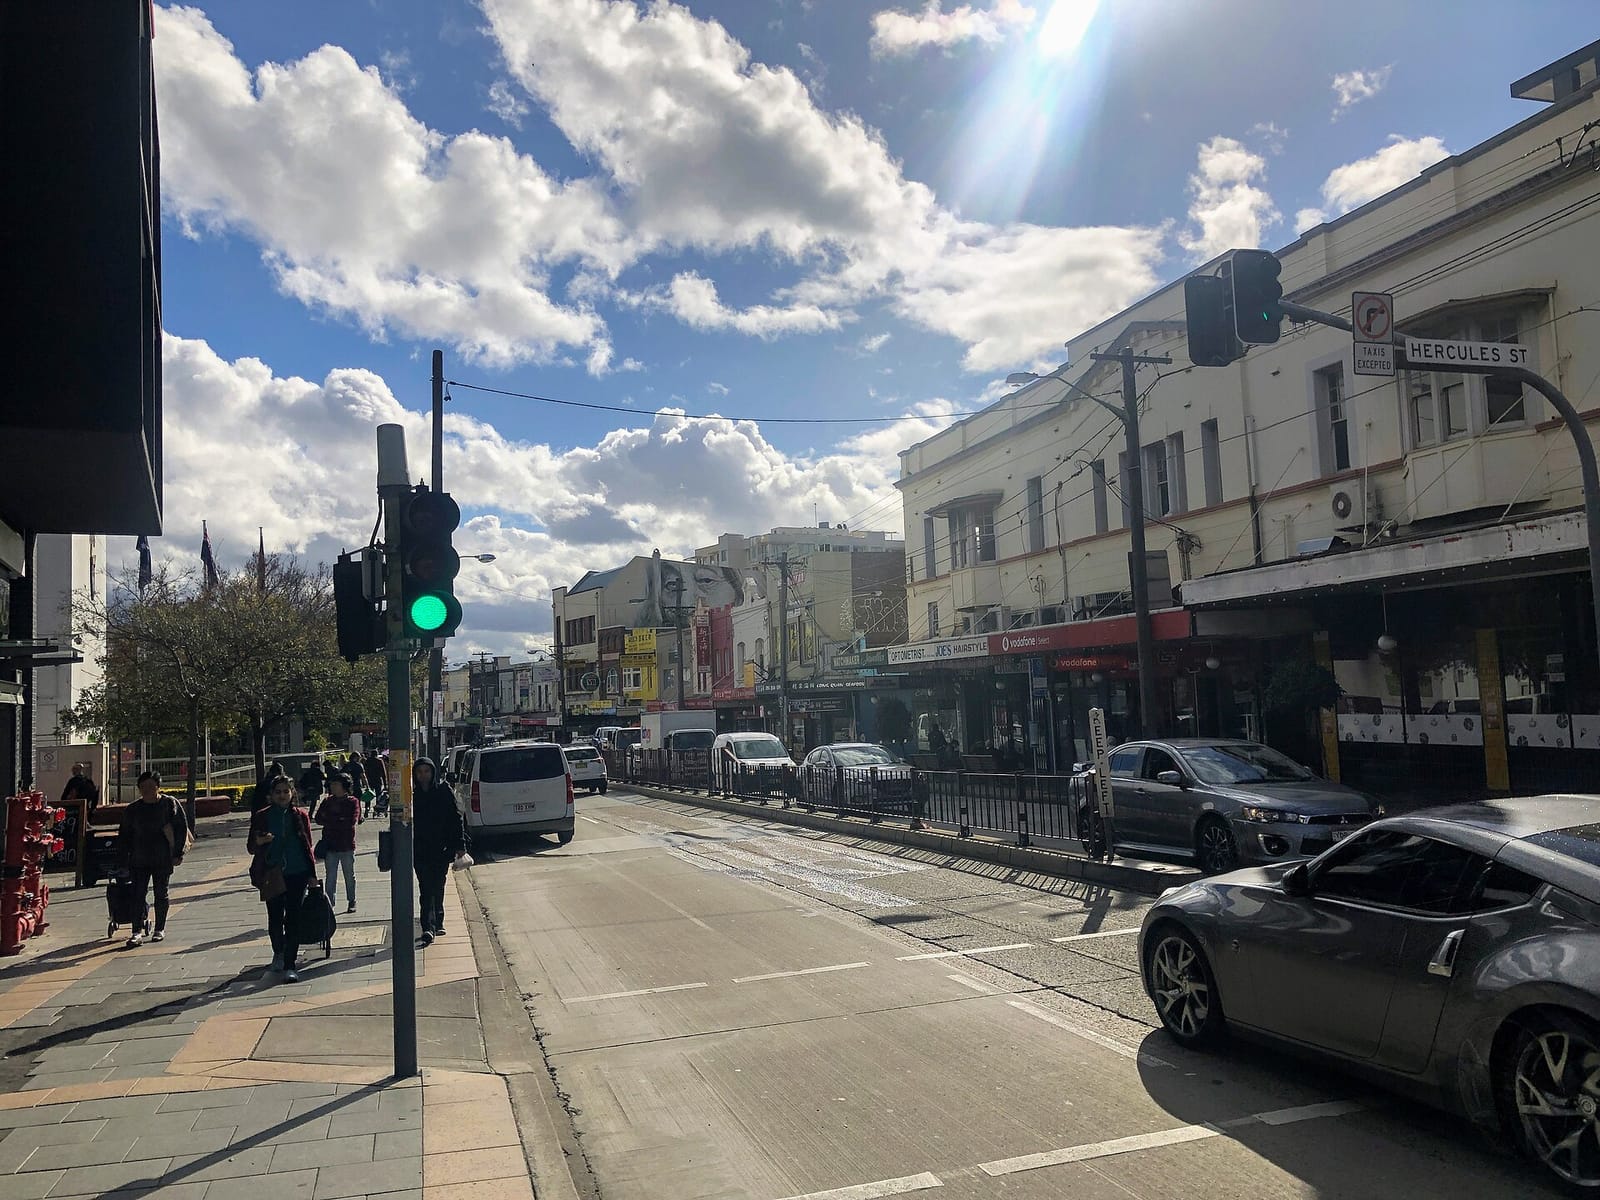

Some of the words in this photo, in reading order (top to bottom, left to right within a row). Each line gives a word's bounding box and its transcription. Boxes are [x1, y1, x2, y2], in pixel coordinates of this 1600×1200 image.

[1362, 346, 1386, 357] TAXIS
[1411, 342, 1501, 362] HERCULES
[1509, 348, 1528, 363] ST
[1357, 359, 1392, 371] EXCEPTED
[953, 641, 987, 653] HAIRSTYLE
[1009, 636, 1036, 648] vodafone
[890, 648, 925, 662] OPTOMETRIST
[1060, 658, 1098, 667] vodafone
[1100, 767, 1109, 815] LEFT
